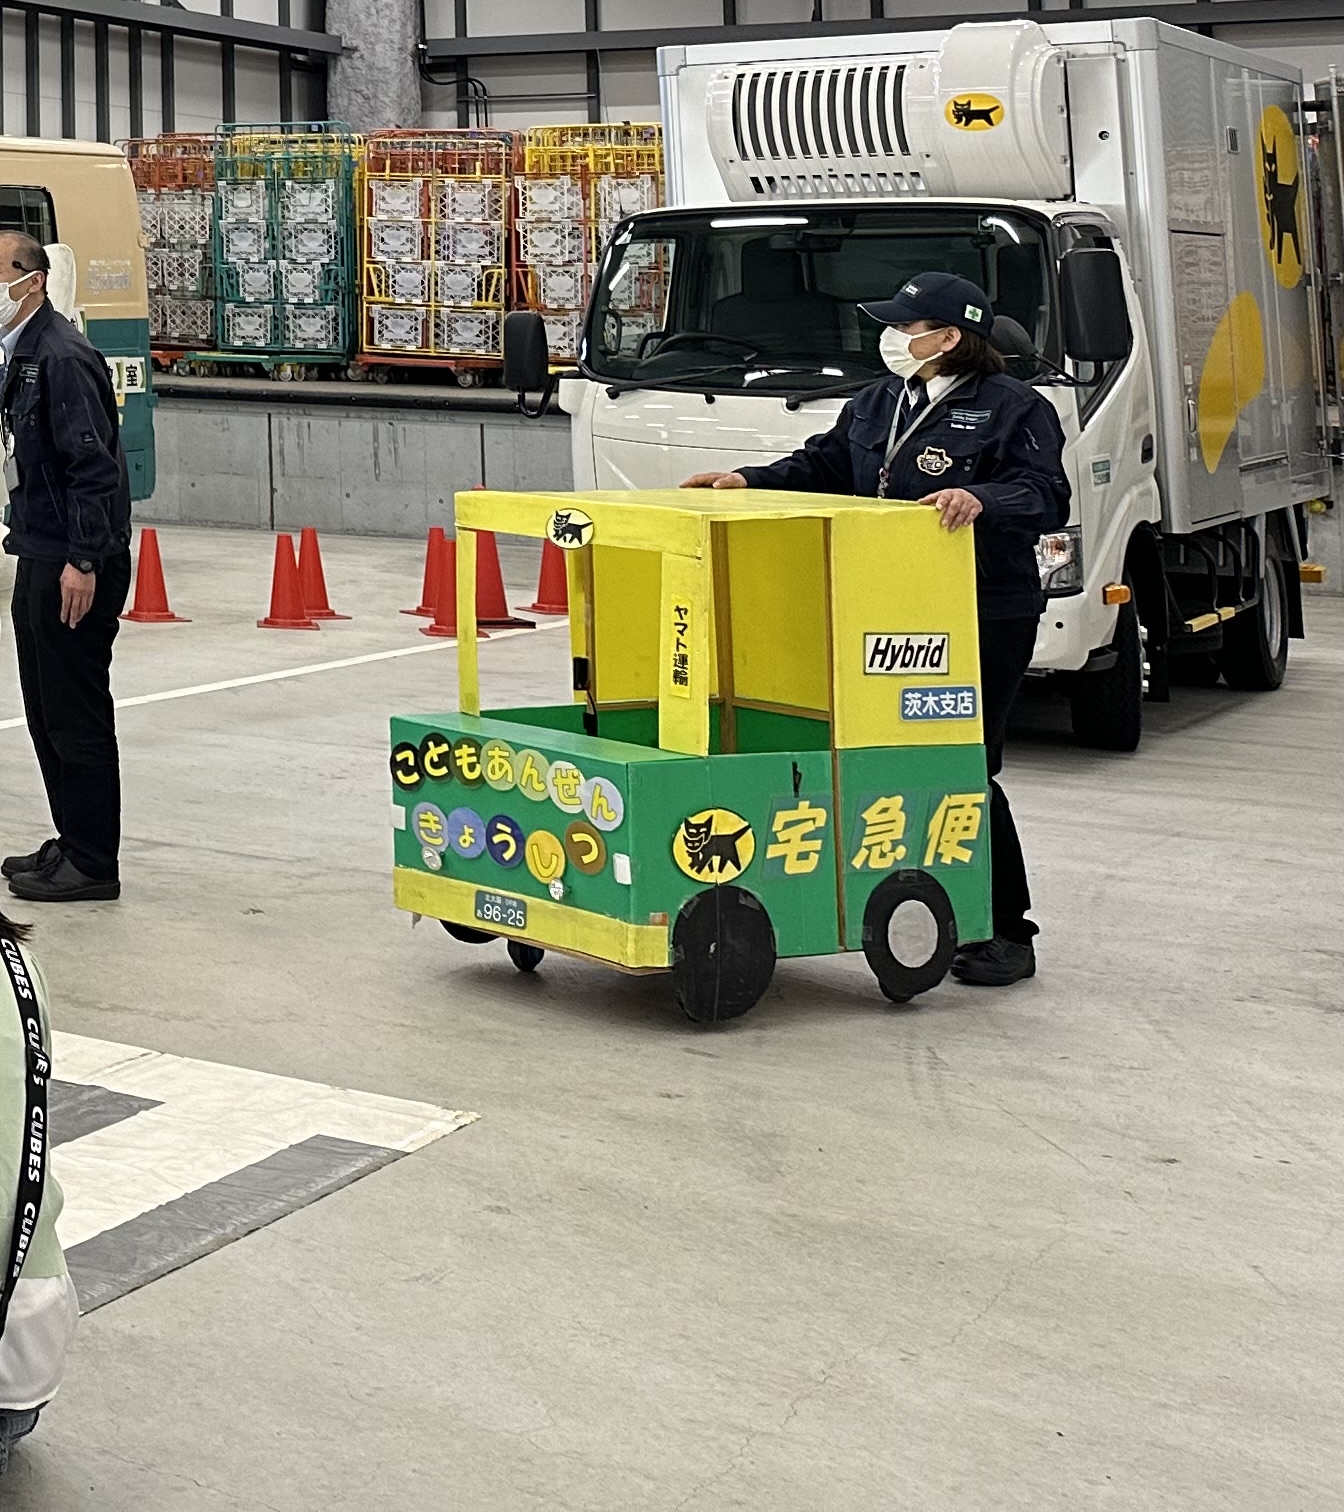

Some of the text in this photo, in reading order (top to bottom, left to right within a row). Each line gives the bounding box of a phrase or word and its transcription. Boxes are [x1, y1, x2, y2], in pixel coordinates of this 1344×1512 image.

[672, 605, 689, 687] ヤマト運輸
[868, 637, 946, 672] Hybrid
[904, 690, 973, 717] 茨木支店
[418, 810, 600, 879] きょうしつ
[766, 792, 987, 875] 宅急便
[483, 903, 525, 927] 96-25
[0, 938, 33, 1001] CUBES
[26, 1017, 49, 1087] CUES
[28, 1105, 44, 1183] CUBES
